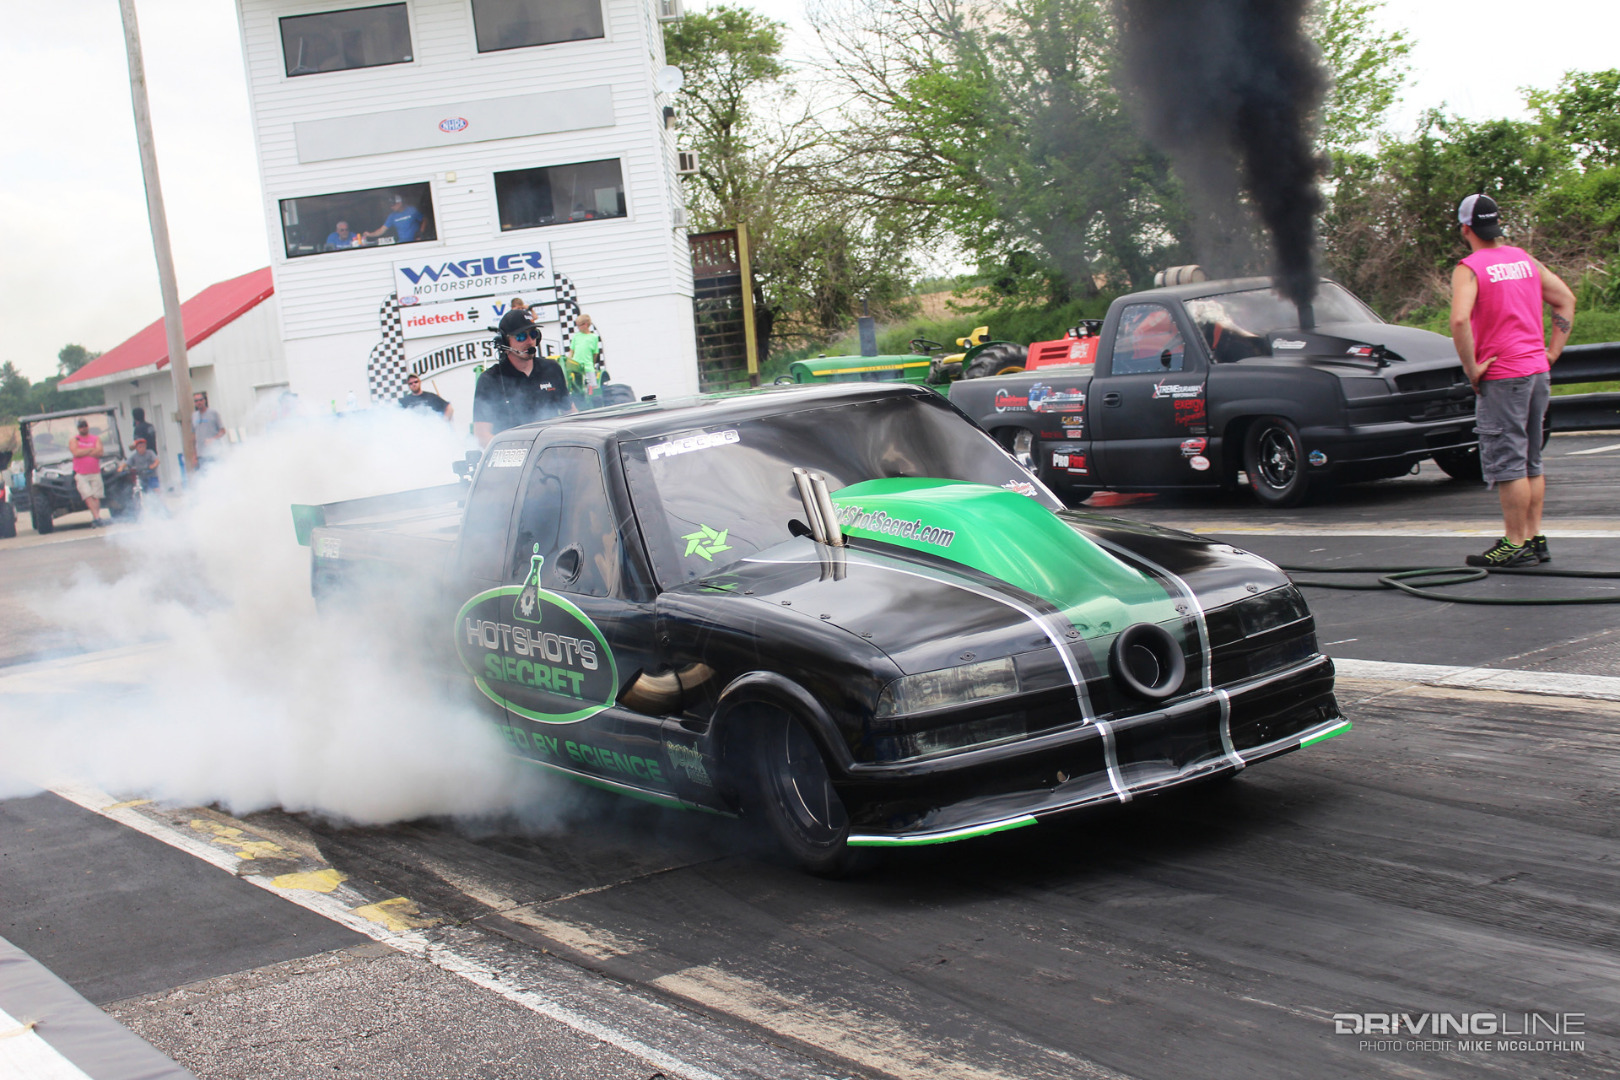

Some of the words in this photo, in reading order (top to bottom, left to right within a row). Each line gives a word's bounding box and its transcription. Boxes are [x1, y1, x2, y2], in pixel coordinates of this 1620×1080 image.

[400, 251, 544, 285] WAGLER
[413, 275, 508, 295] MOTORSPORTS
[512, 270, 546, 282] PARK
[1485, 260, 1534, 283] SECURITY
[407, 311, 465, 327] ridetech
[412, 340, 493, 377] WINNER'S
[484, 653, 584, 701] SECRET
[532, 732, 562, 757] BY
[565, 739, 667, 784] SCIENCE
